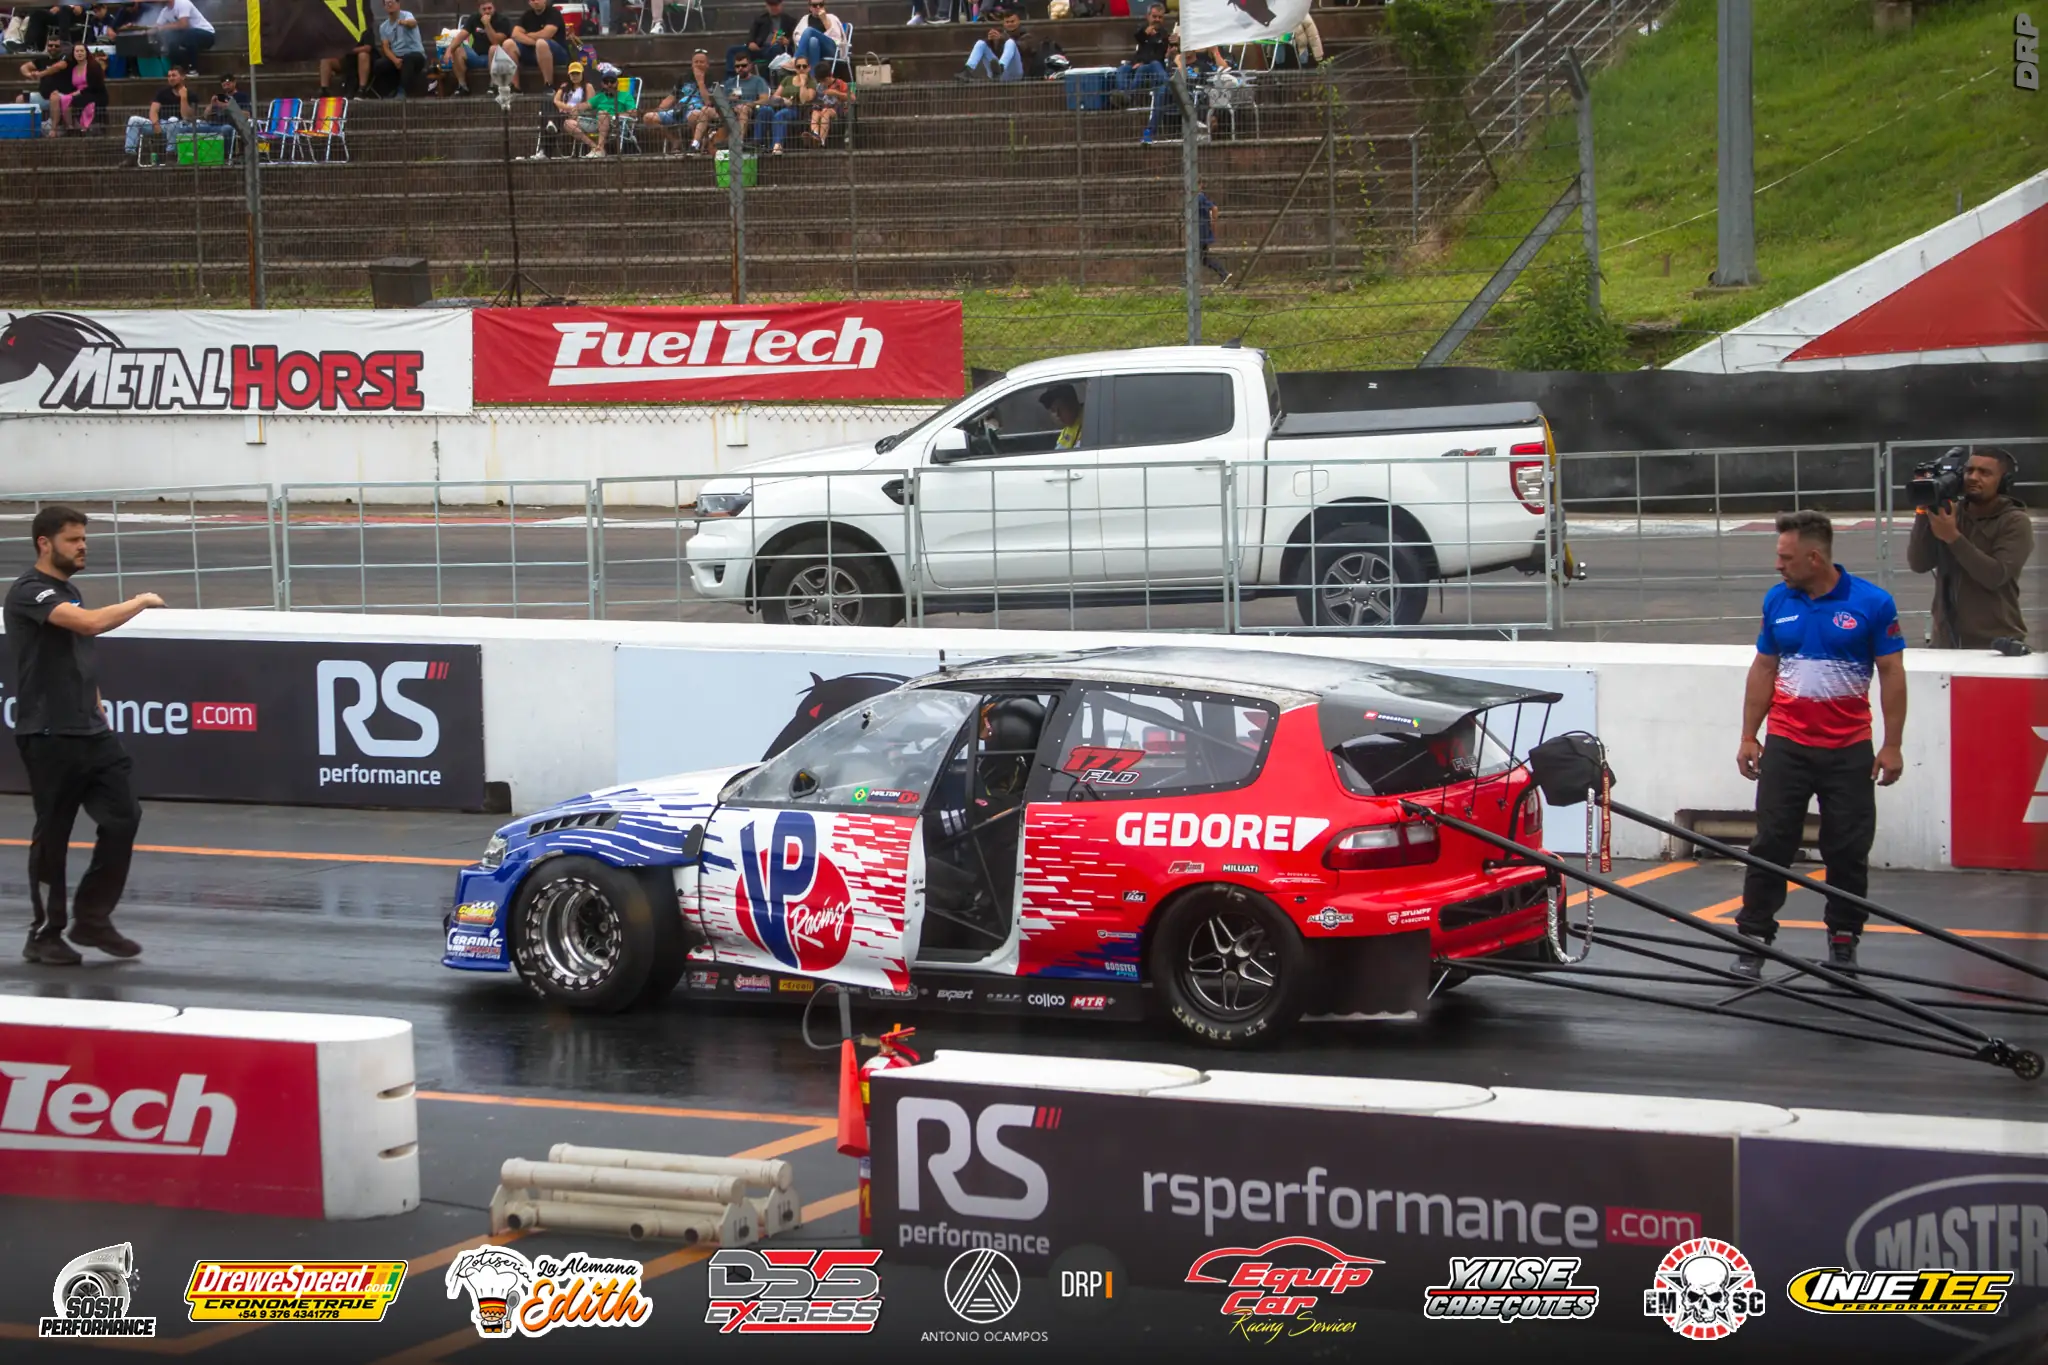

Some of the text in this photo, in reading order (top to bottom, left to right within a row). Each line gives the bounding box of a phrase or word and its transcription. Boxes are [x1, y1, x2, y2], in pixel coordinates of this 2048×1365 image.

[552, 317, 884, 370] FuelTech
[316, 659, 440, 758] RS
[319, 764, 442, 786] performance
[1116, 812, 1292, 851] GEDORE
[740, 811, 817, 969] VP
[790, 896, 853, 950] Racing
[1073, 996, 1104, 1007] MTR
[896, 1096, 1050, 1220] RS
[899, 1221, 1051, 1255] performance
